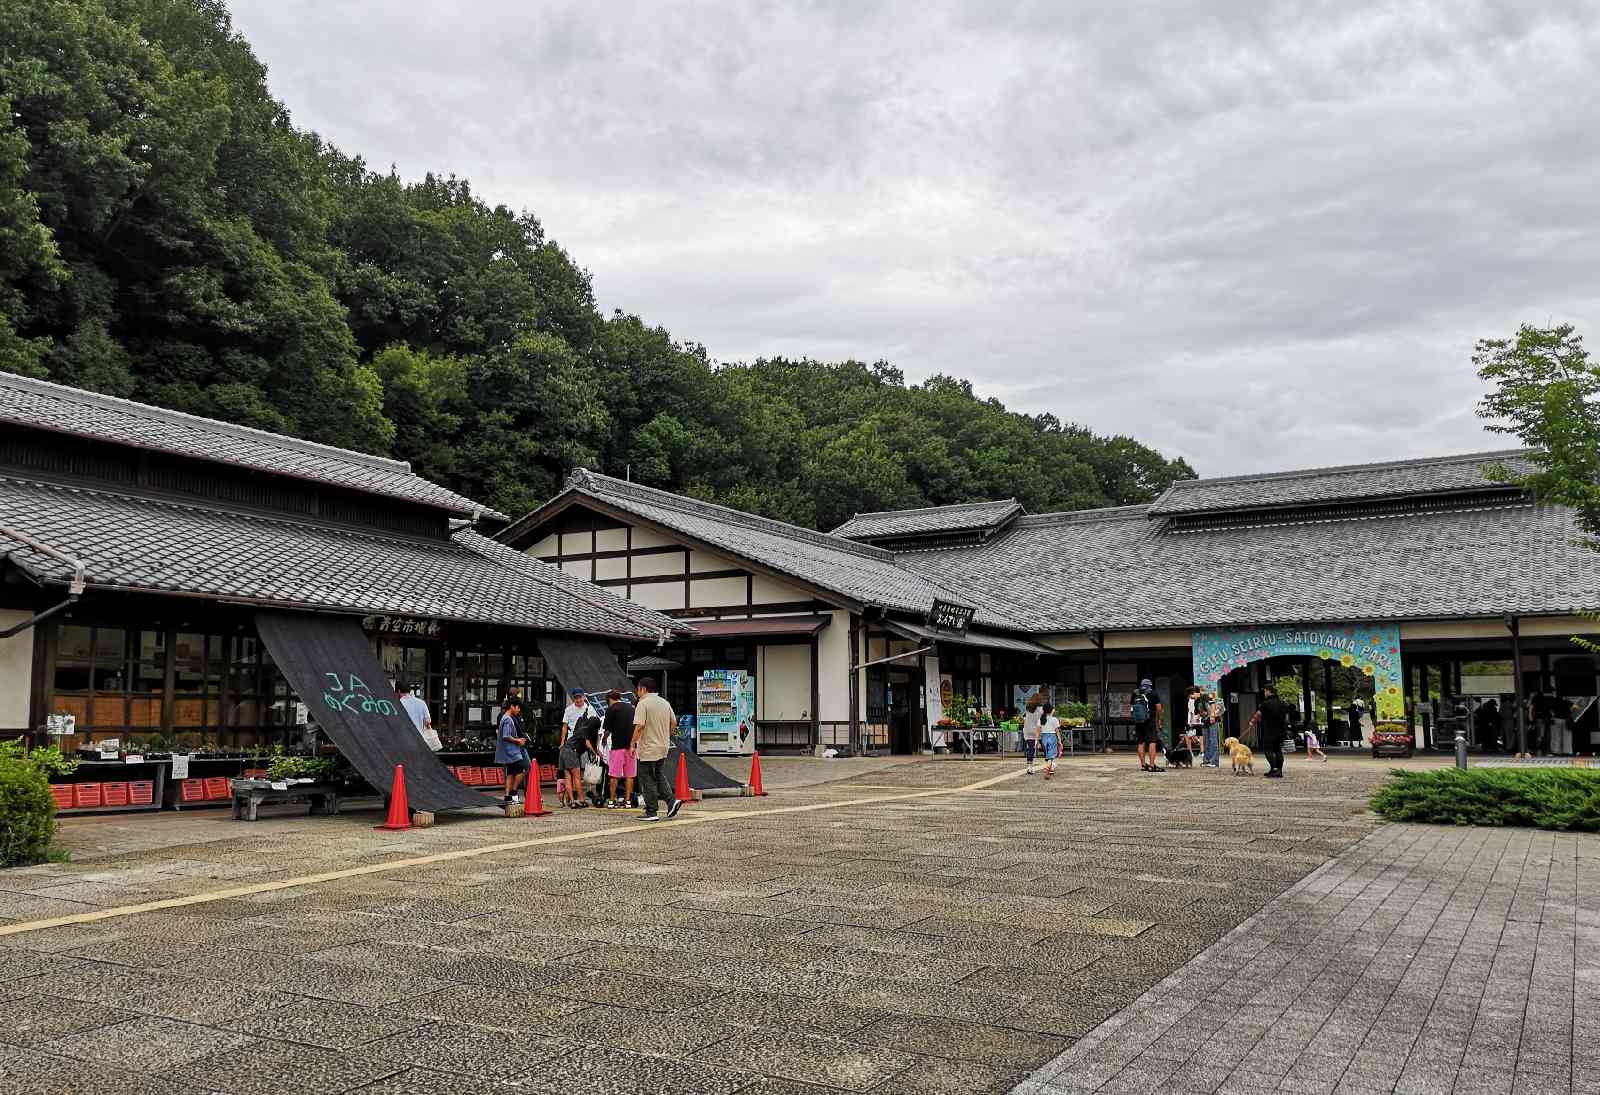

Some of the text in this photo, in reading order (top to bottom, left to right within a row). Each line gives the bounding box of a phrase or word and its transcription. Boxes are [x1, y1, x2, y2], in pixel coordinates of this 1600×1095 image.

[1200, 630, 1393, 673] GIFU SEIRYU-SATOYAMA PARK
[325, 672, 373, 694] JA
